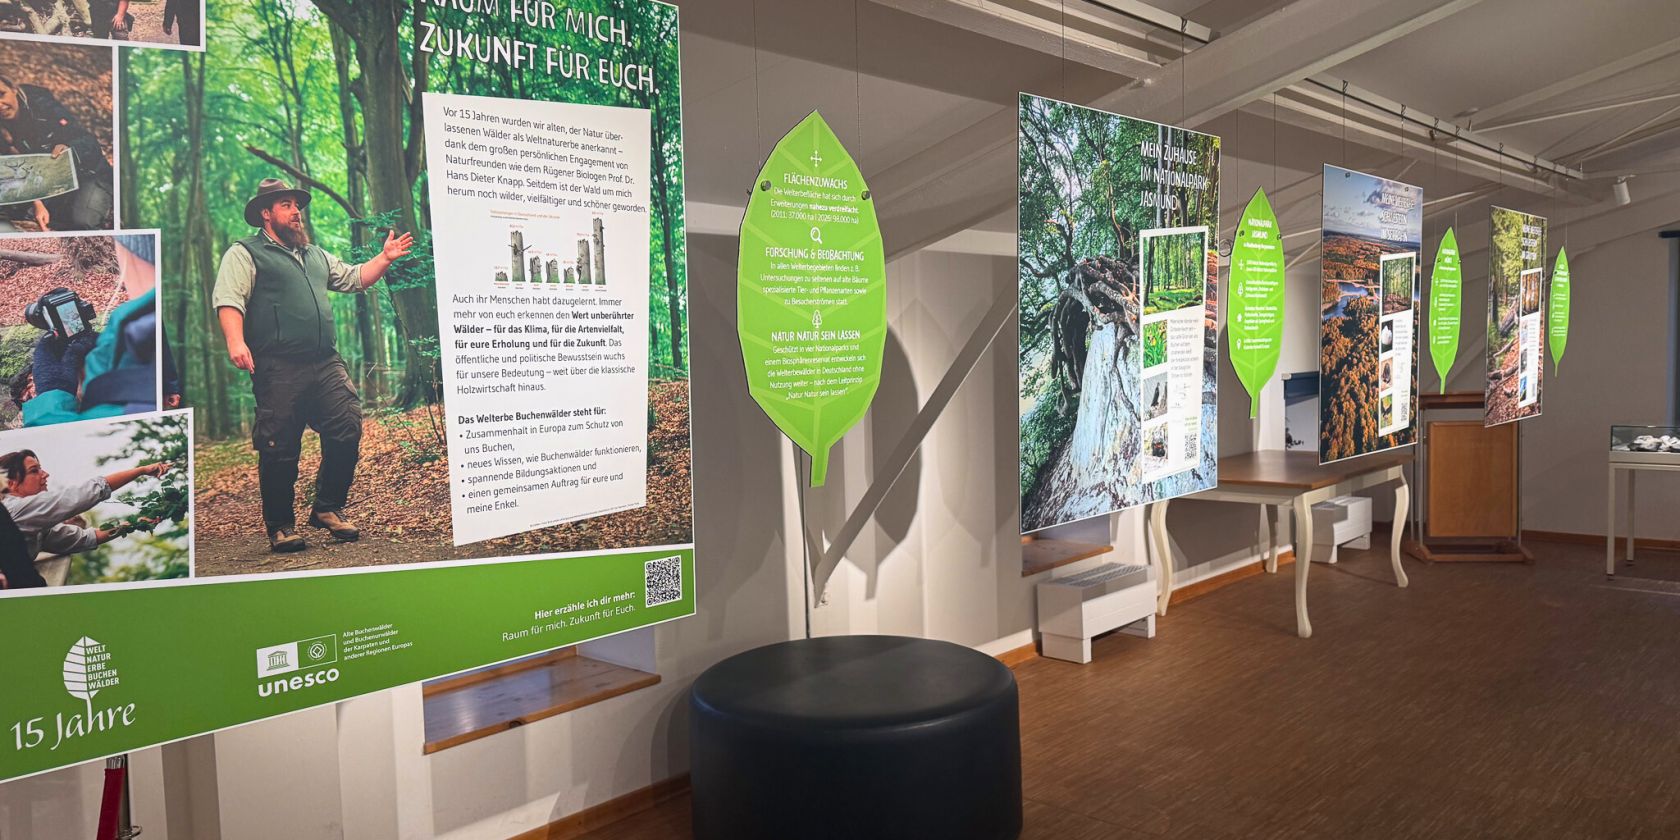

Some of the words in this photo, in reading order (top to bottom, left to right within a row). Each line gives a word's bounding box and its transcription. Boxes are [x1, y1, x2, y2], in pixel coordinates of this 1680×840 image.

[566, 8, 632, 48] MICH.
[420, 21, 538, 70] ZUKUNFT
[547, 44, 590, 80] FÜR
[599, 58, 660, 95] EUCH.
[443, 106, 458, 117] Vor
[459, 108, 471, 119] 15
[472, 110, 500, 123] Jahren
[501, 117, 531, 128] wurden
[532, 120, 545, 130] wir
[546, 122, 568, 135] alten,
[568, 126, 581, 135] der
[582, 127, 603, 138] Natur
[604, 130, 623, 141] über-
[443, 122, 481, 136] lassenen
[482, 127, 511, 140] Wälder
[512, 132, 524, 142] als
[525, 133, 579, 150] Weltnaturerbe
[580, 143, 617, 155] anerkannt
[444, 138, 467, 150] dank
[467, 141, 487, 152] dem
[488, 145, 518, 156] großen
[519, 149, 568, 162] persönlichen
[569, 154, 615, 168] Engagement
[615, 162, 628, 170] von
[1141, 141, 1162, 158] MEIN
[1164, 145, 1196, 165] ZUHAUSE
[445, 153, 507, 170] Naturfreunden
[508, 161, 522, 172] wie
[523, 163, 541, 174] dem
[543, 165, 574, 178] Rügener
[576, 169, 607, 183] Biologen
[608, 173, 623, 183] Prof.
[624, 174, 634, 184] Dr.
[1141, 166, 1151, 181] IM
[1154, 168, 1208, 190] NATIONALPARK
[784, 172, 848, 189] FLÄCHENZUWACHS
[447, 185, 475, 197] herum
[477, 189, 498, 199] noch
[498, 190, 526, 203] wilder,
[526, 194, 566, 208] vielfältiger
[567, 197, 582, 207] und
[583, 199, 611, 210] schöner
[612, 202, 647, 214] geworden.
[1140, 190, 1177, 210] JASMUND
[766, 247, 808, 259] FORSCHUNG
[810, 249, 816, 259] &
[818, 249, 864, 261] BEOBACHTUNG
[452, 293, 474, 304] Auch
[476, 294, 488, 304] ihr
[489, 294, 530, 305] Menschen
[532, 295, 550, 305] habt
[551, 296, 597, 308] dazugelernt.
[598, 297, 622, 306] Immer
[453, 309, 476, 318] mehr
[495, 310, 515, 319] euch
[517, 310, 554, 319] erkennen
[555, 310, 570, 319] den
[571, 310, 589, 319] Wert
[590, 311, 634, 320] unberührter
[453, 324, 484, 334] Wälder
[493, 324, 506, 334] für
[507, 324, 522, 334] das
[524, 324, 550, 335] Klima,
[551, 324, 563, 333] für
[564, 324, 576, 333] die
[577, 324, 624, 334] Artenvielfalt,
[772, 331, 794, 342] NATUR
[797, 331, 818, 340] NATUR
[821, 330, 836, 340] SEIN
[838, 330, 860, 340] LASSEN
[454, 339, 468, 349] für
[491, 339, 530, 350] Erholung
[532, 339, 548, 348] und
[549, 338, 562, 348] für
[562, 338, 575, 347] die
[576, 338, 606, 347] Zukunft.
[608, 338, 622, 347] Das
[457, 415, 474, 424] Das
[475, 412, 514, 423] Welterbe
[515, 409, 571, 421] Buchenwälder
[572, 407, 592, 417] steht
[593, 406, 606, 415] für:
[465, 426, 528, 439] Zusammenhalt
[529, 425, 538, 434] in
[539, 424, 566, 434] Europa
[568, 423, 584, 431] zum
[585, 420, 609, 430] Schutz
[464, 446, 480, 454] uns
[481, 442, 515, 453] Buchen,
[467, 459, 492, 469] neues
[493, 456, 524, 466] Wissen,
[525, 453, 539, 463] wie
[540, 448, 593, 462] Buchenwälder
[594, 445, 641, 456] funktionieren,
[467, 470, 514, 485] spannende
[515, 464, 581, 479] Bildungsaktionen
[582, 461, 597, 471] und
[468, 489, 491, 499] einen
[493, 482, 549, 498] gemeinsamen
[550, 478, 579, 488] Auftrag
[580, 475, 591, 484] für
[592, 475, 608, 483] eure
[609, 472, 623, 481] und
[466, 503, 493, 514] meine
[494, 498, 518, 510] Enkel.
[534, 609, 553, 620] Hier
[554, 601, 585, 615] erzähle
[586, 598, 598, 608] ich
[599, 595, 611, 605] dir
[612, 591, 635, 602] mehr:
[502, 629, 529, 642] Raum
[530, 624, 543, 635] für
[545, 619, 568, 631] mich.
[569, 611, 600, 626] Zukunft
[602, 608, 614, 618] für
[615, 603, 636, 615] Euch.
[86, 645, 106, 654] WELT
[344, 651, 365, 660] anderer
[366, 646, 391, 658] Regionen
[392, 641, 413, 652] Europas
[353, 642, 378, 652] Karpaten
[87, 653, 111, 663] NATUR
[88, 663, 106, 672] ERBE
[88, 669, 117, 680] BUCHEN
[89, 677, 119, 689] WÄLDER
[258, 668, 340, 697] unesco
[10, 716, 44, 750] 15
[50, 702, 136, 750] Jahre
